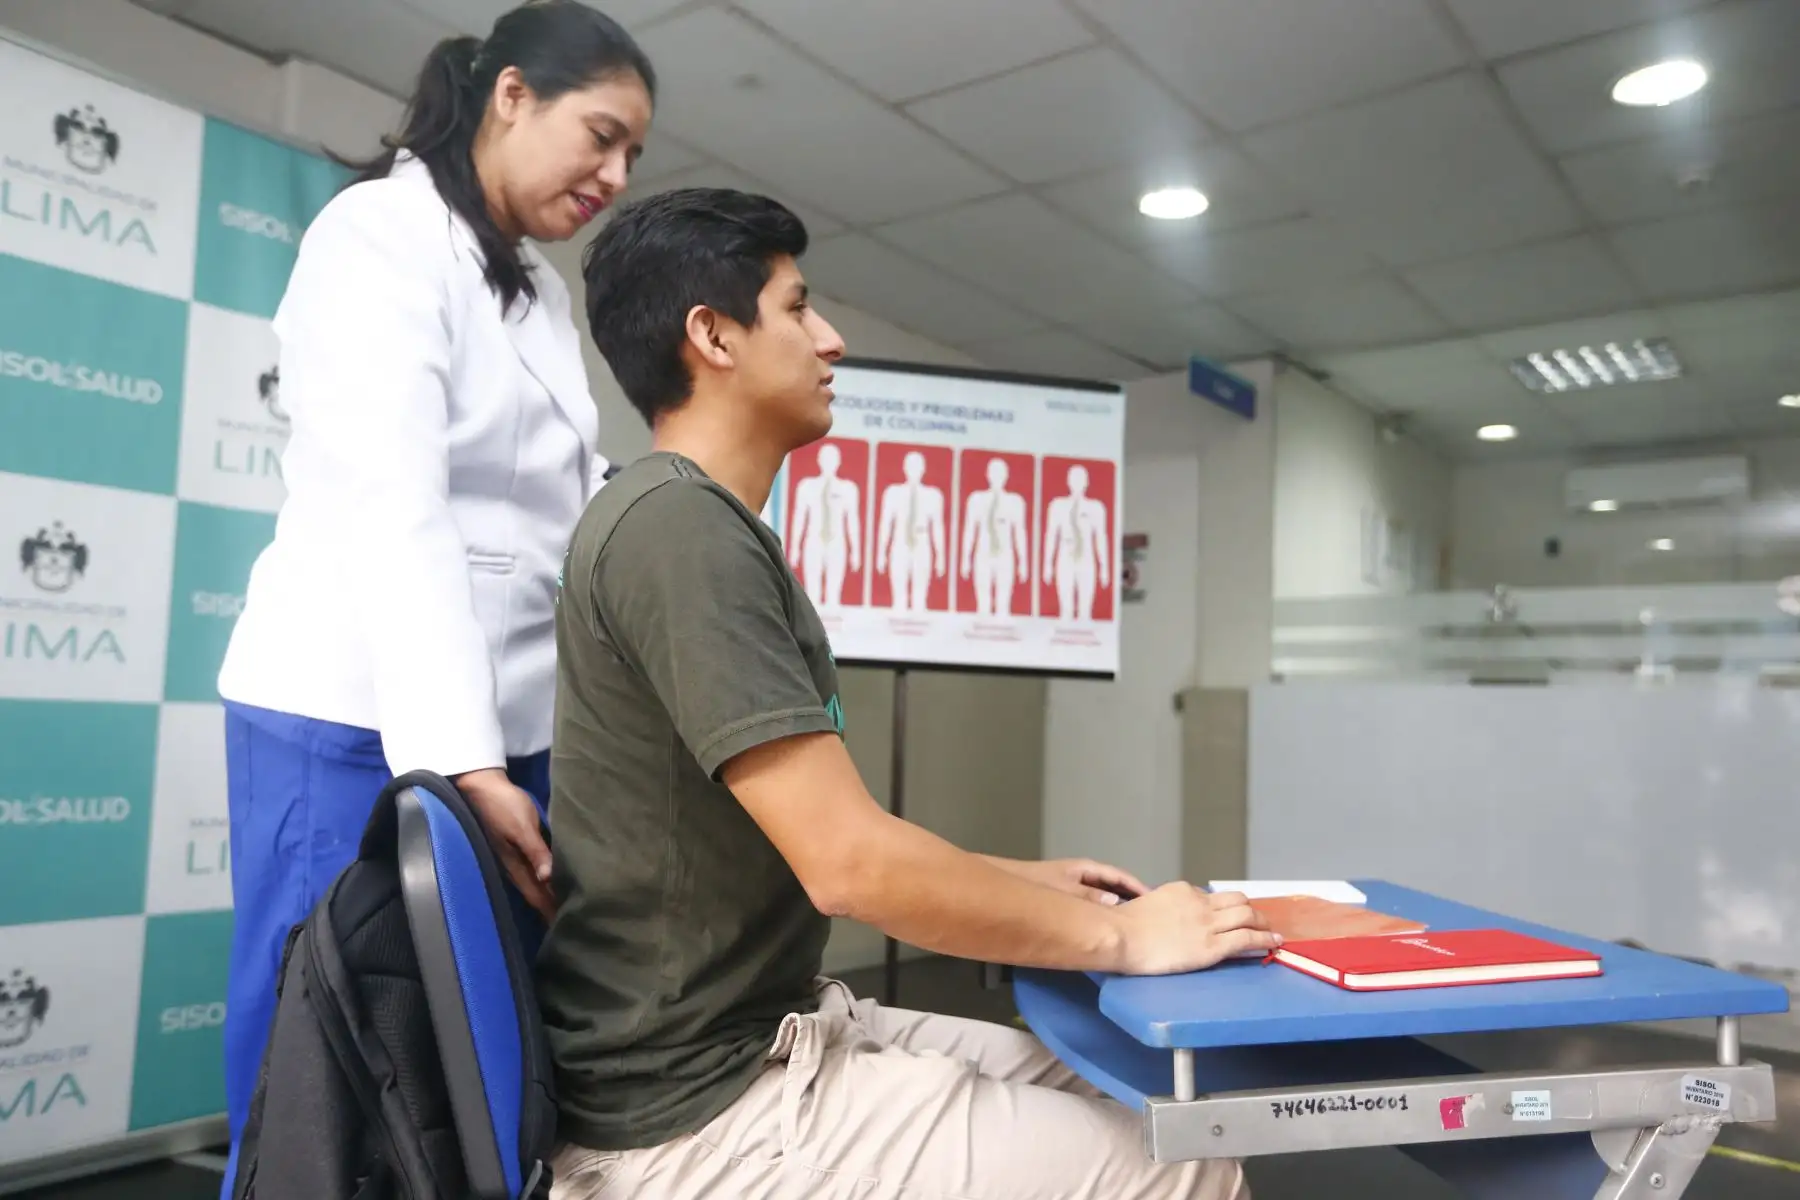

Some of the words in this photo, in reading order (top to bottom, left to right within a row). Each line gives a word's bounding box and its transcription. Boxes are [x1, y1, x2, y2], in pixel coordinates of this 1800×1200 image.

[1, 178, 158, 257] LIMA
[72, 364, 164, 405] SALUD
[4, 620, 127, 664] IMA
[36, 795, 132, 823] SALUD
[186, 839, 228, 877] LI
[159, 1001, 227, 1034] SISO
[1694, 1079, 1717, 1090] SISOL
[1270, 1094, 1409, 1118] 74646221-0001
